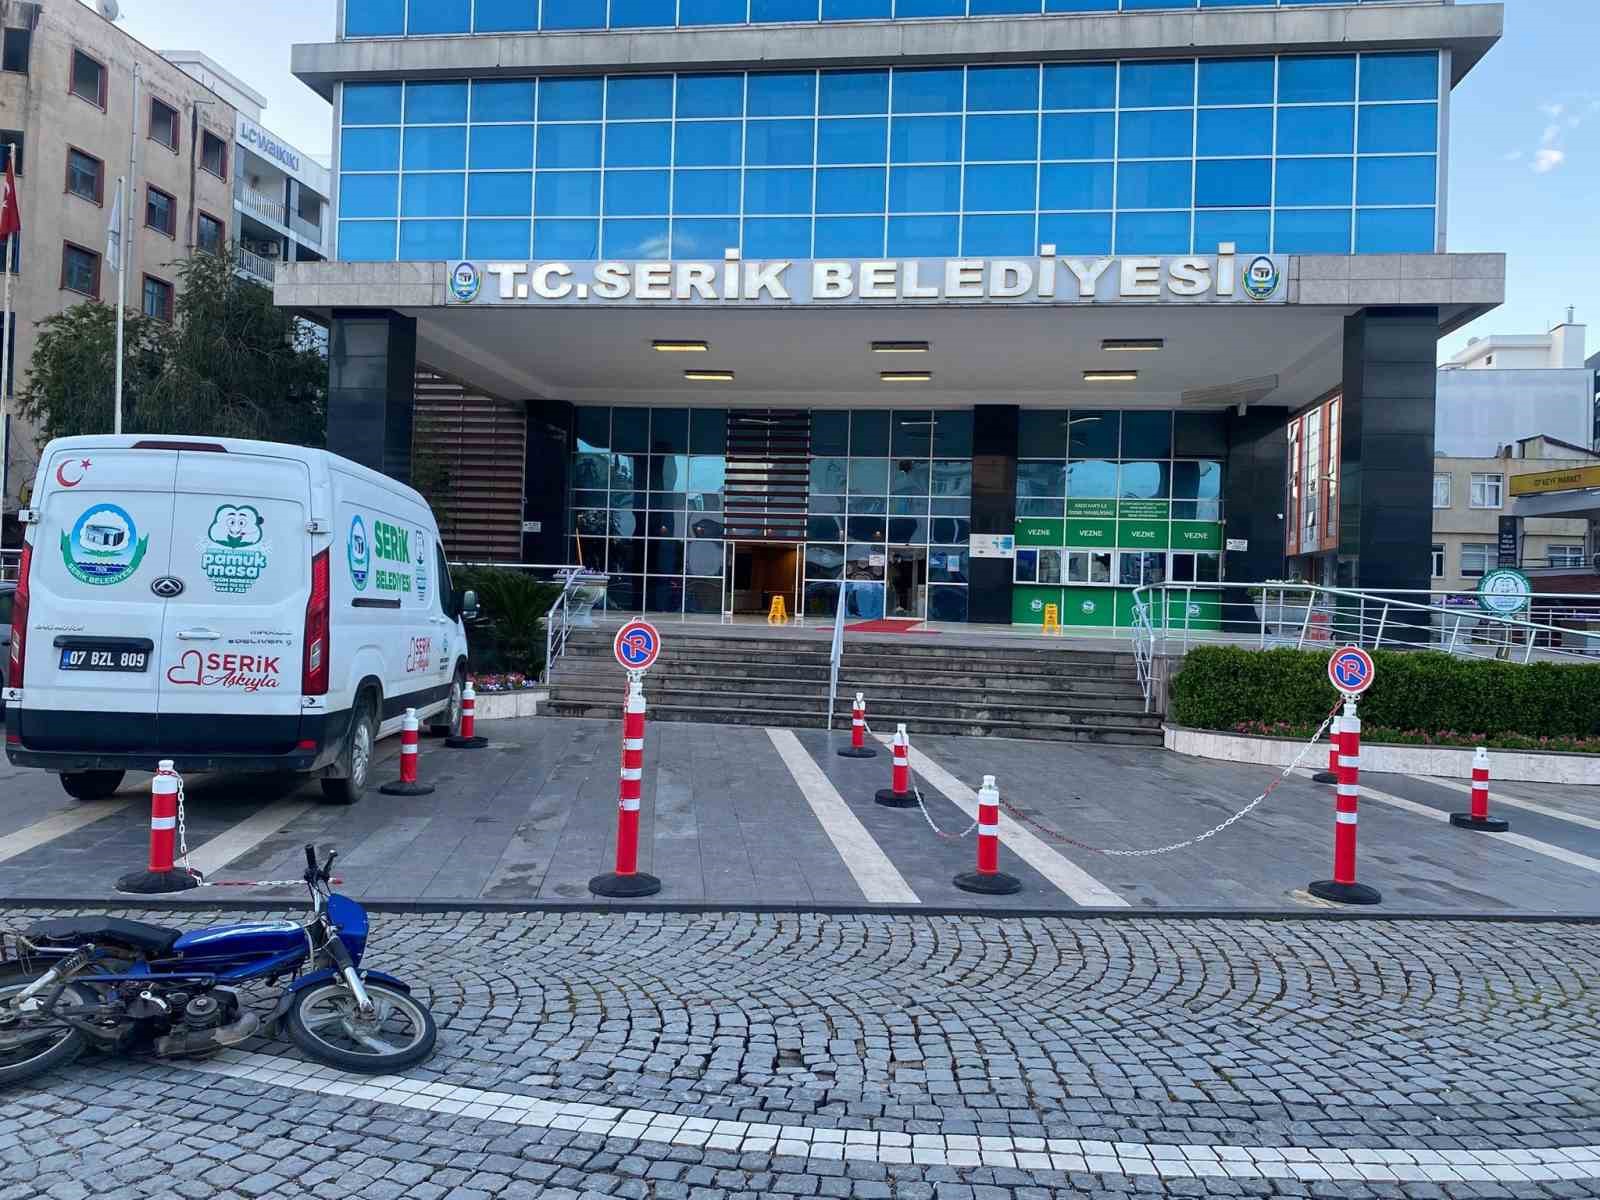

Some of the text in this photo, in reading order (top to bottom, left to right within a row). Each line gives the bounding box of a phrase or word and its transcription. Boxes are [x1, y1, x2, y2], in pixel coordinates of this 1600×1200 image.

[813, 242, 1236, 300] BELEDİYESİ
[1079, 529, 1103, 537] VEZNE
[1131, 530, 1155, 538] VEZNE
[201, 551, 267, 569] pamuk
[207, 564, 259, 579] masa
[70, 651, 87, 665] 07
[91, 652, 115, 666] BZL
[120, 653, 145, 667] 809
